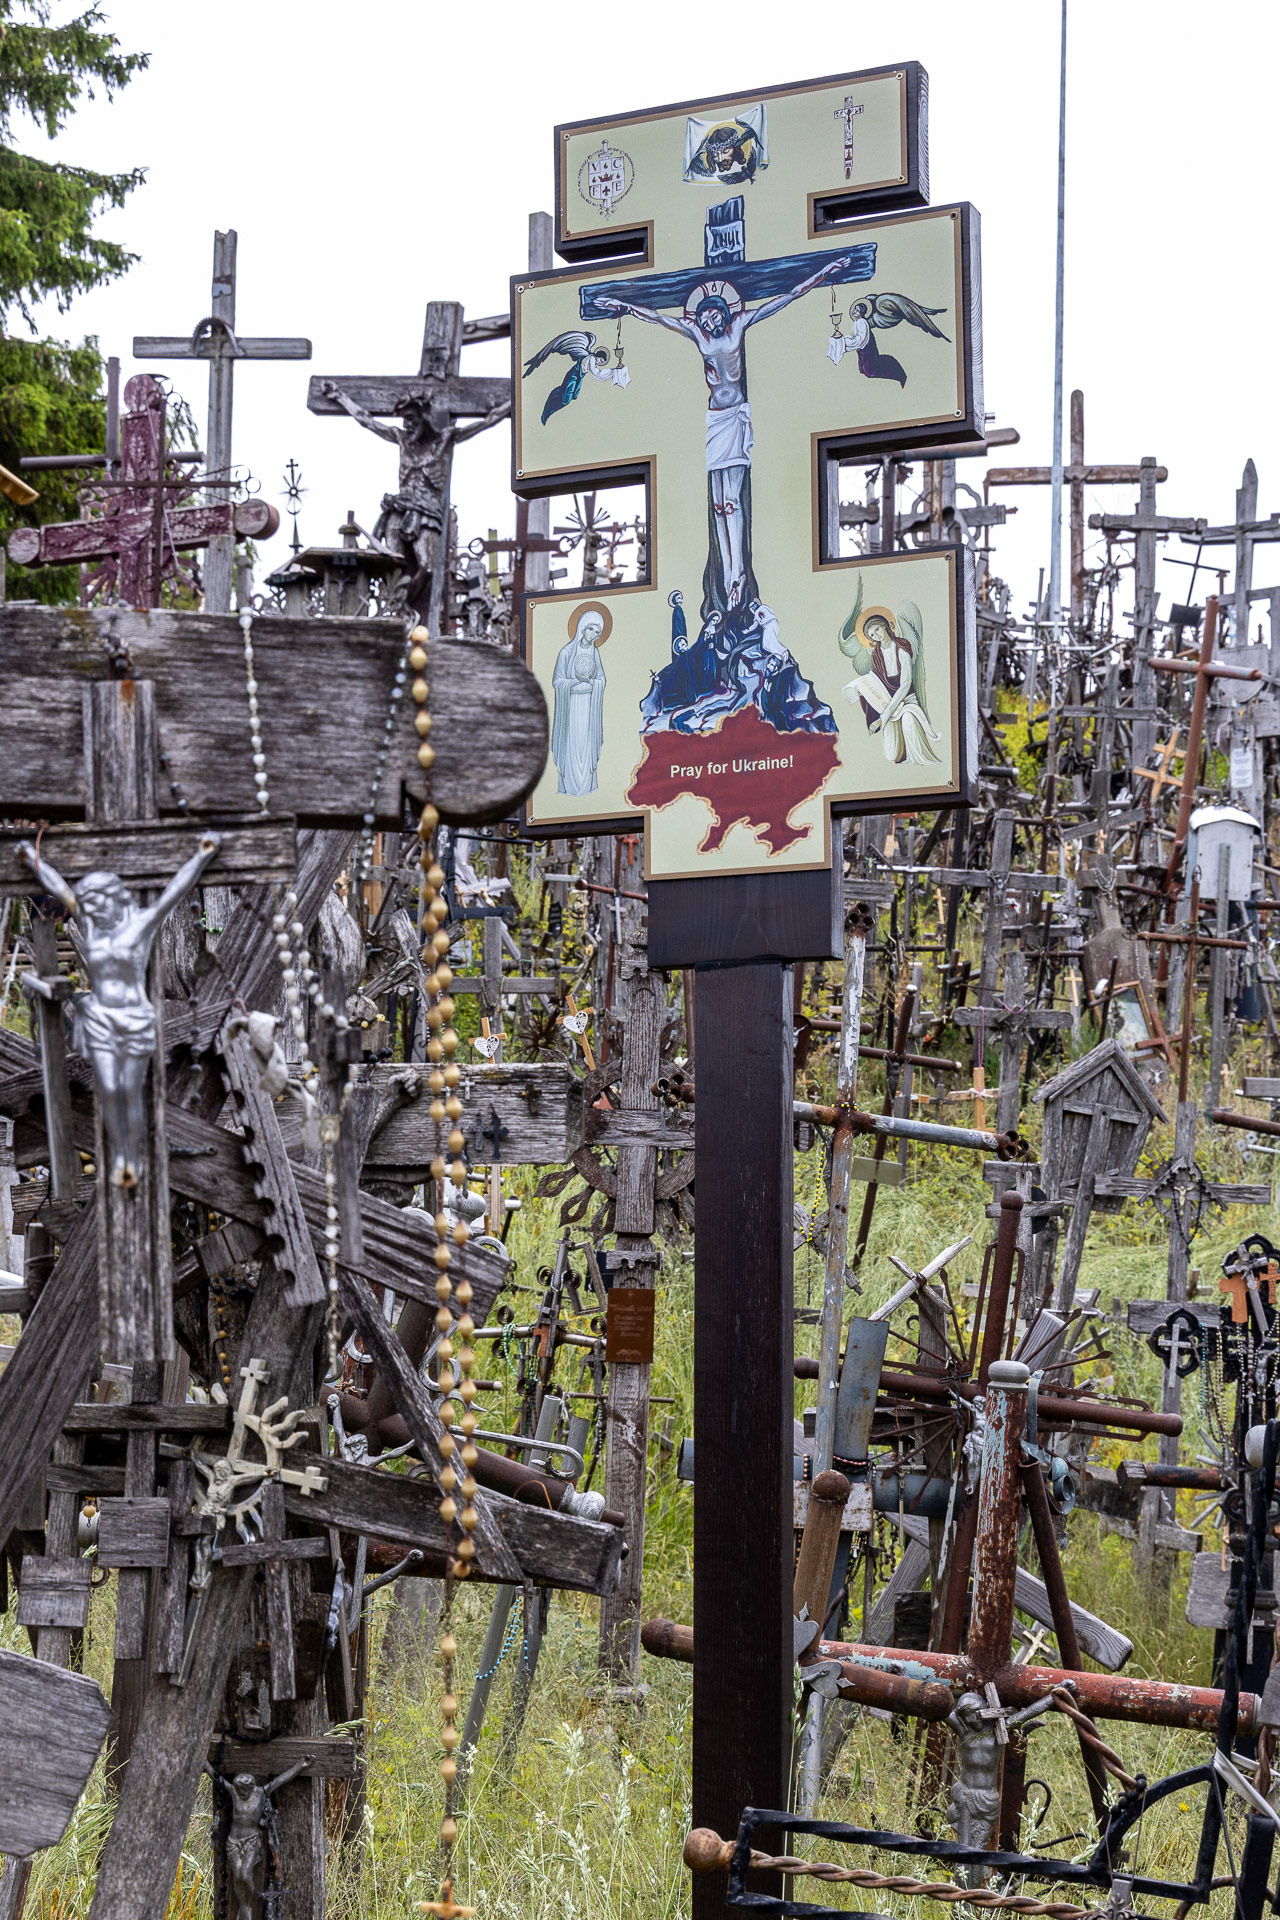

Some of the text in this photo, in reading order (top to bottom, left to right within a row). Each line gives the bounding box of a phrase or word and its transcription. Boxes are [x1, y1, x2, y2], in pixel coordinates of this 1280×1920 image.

[591, 159, 622, 172] V C
[615, 181, 622, 192] E
[670, 754, 794, 779] Pray for Ukraine!
